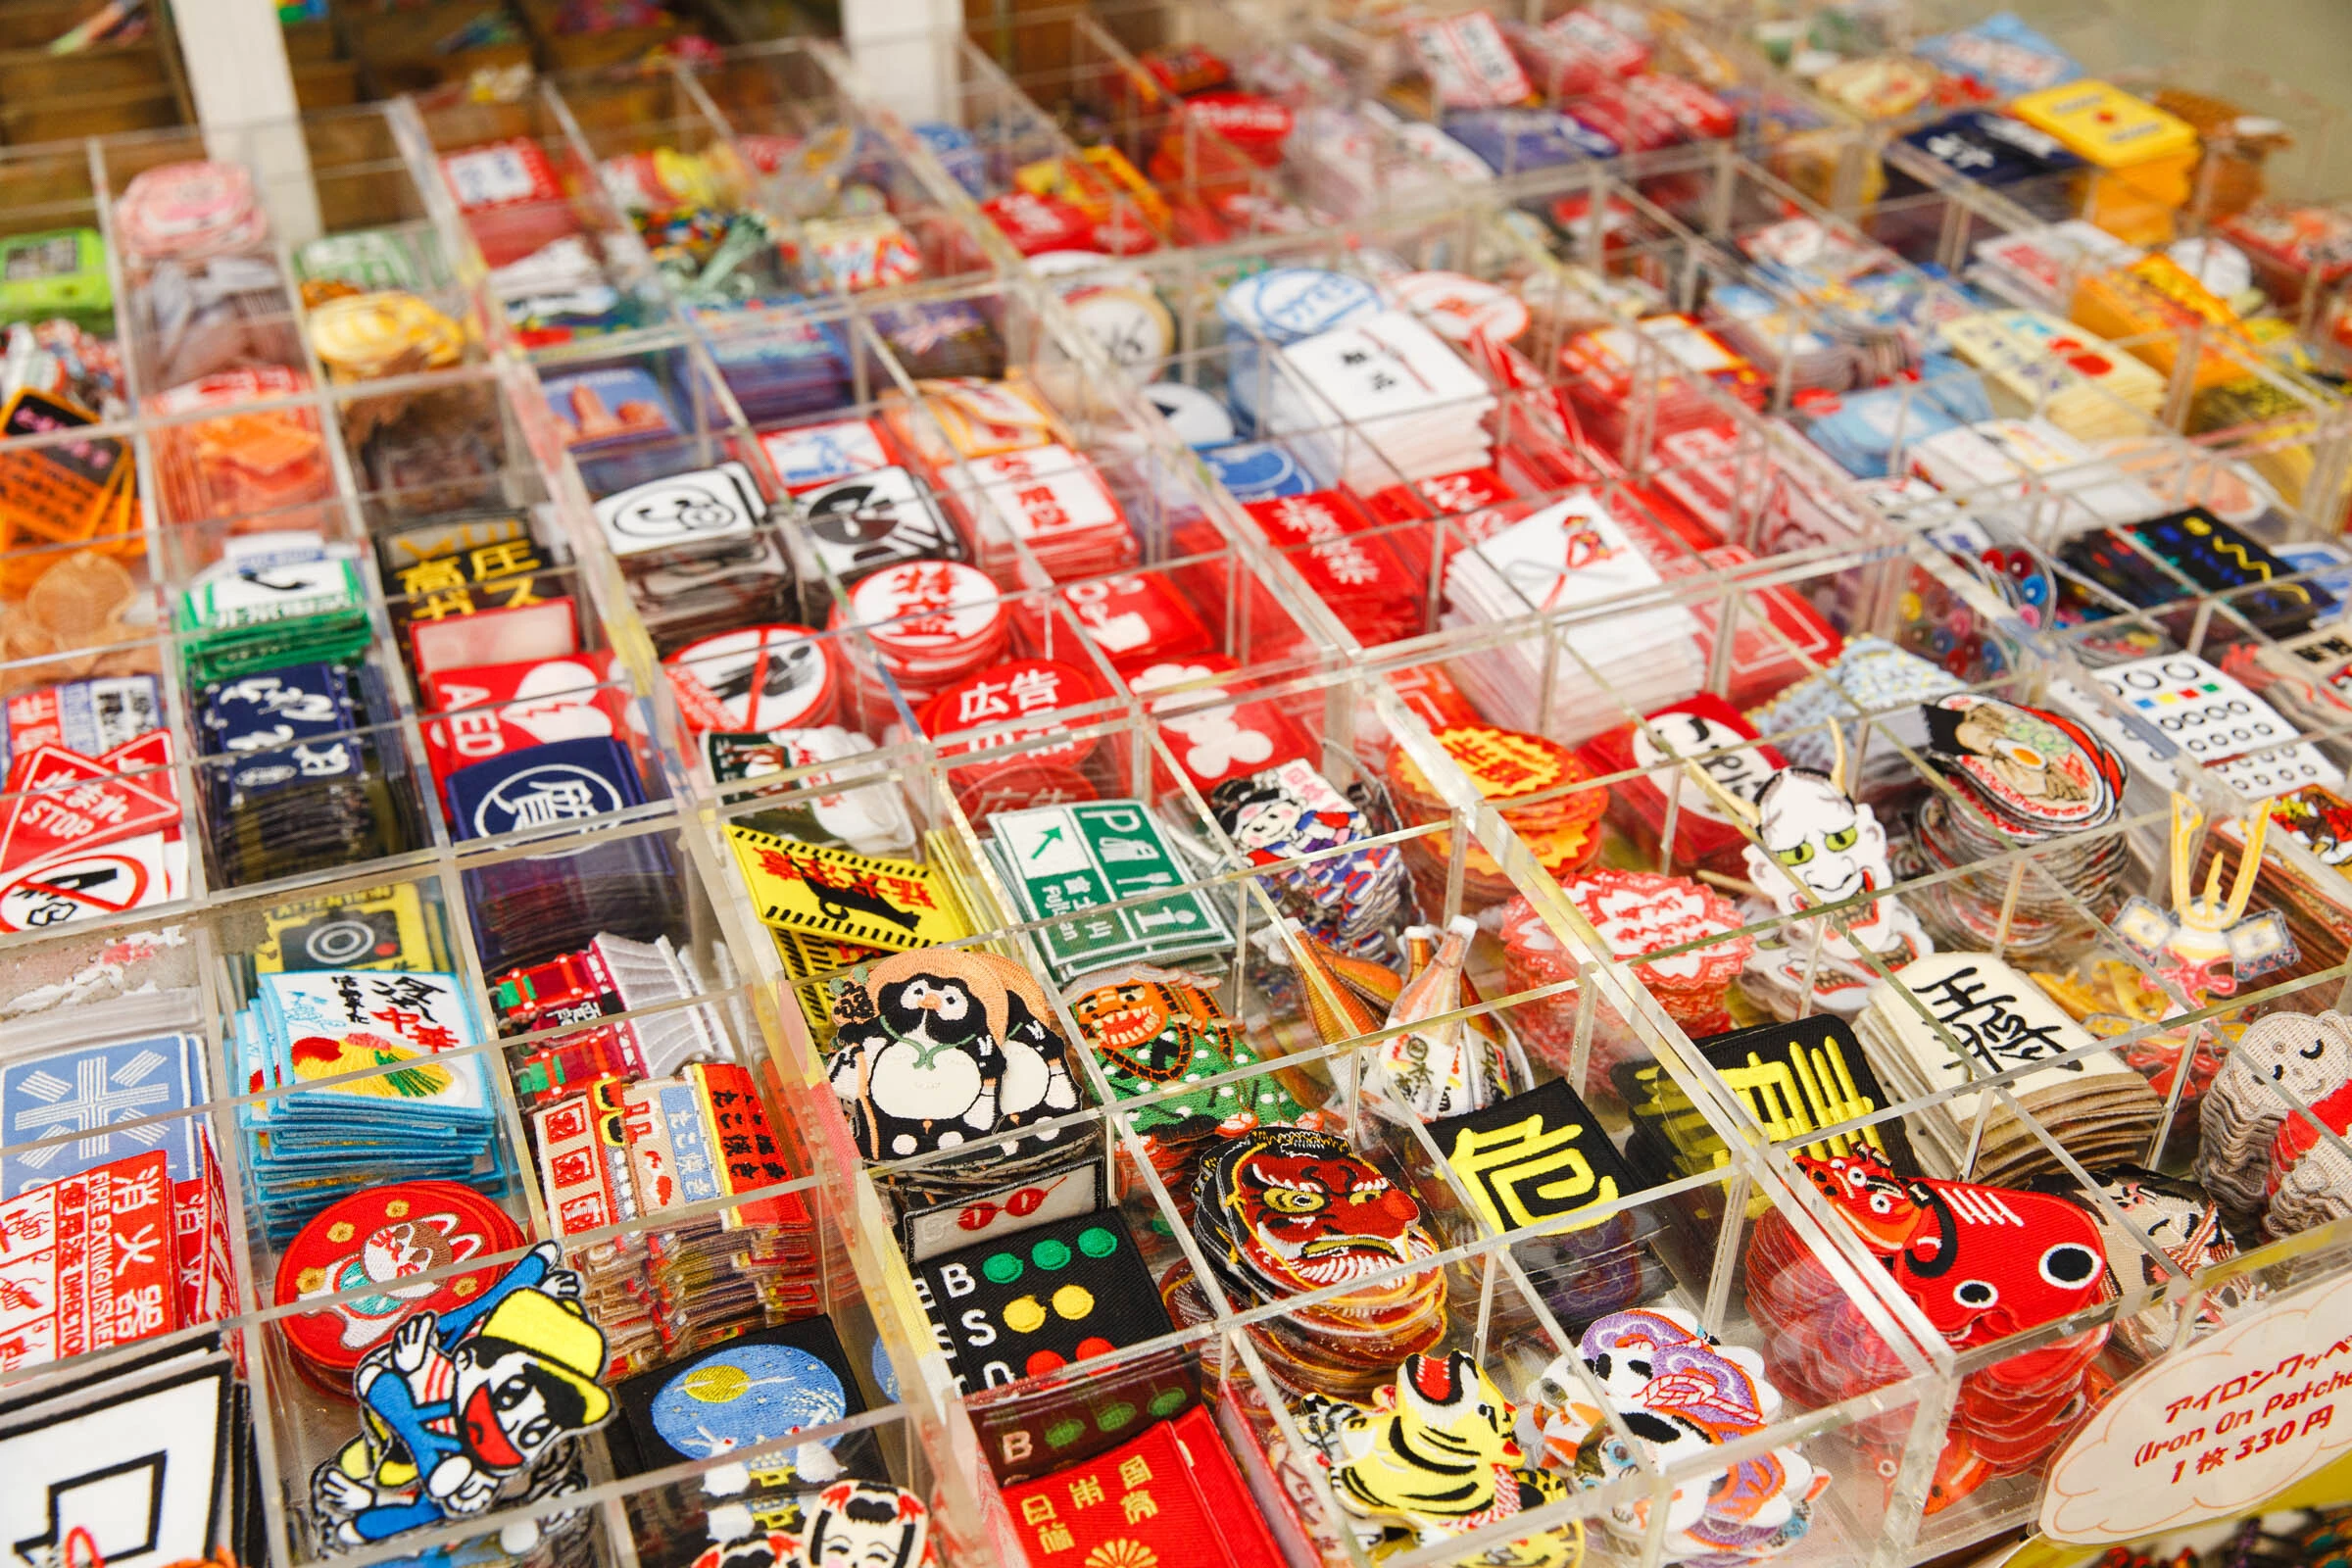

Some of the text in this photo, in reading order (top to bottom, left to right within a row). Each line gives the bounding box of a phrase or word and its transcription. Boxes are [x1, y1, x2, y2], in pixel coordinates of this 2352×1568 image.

[439, 683, 506, 758] AED
[958, 668, 1061, 723] 広告
[21, 802, 96, 841] STOP
[751, 845, 938, 911] 猛犬注意
[668, 1109, 712, 1200] たこ焼き
[712, 1090, 761, 1180] たこ焼き
[89, 1170, 112, 1215] FIRE
[1435, 1113, 1620, 1247] 危
[111, 1164, 164, 1341] 消火器
[939, 1262, 976, 1298] B
[960, 1309, 998, 1348] S
[2215, 1408, 2254, 1436] On
